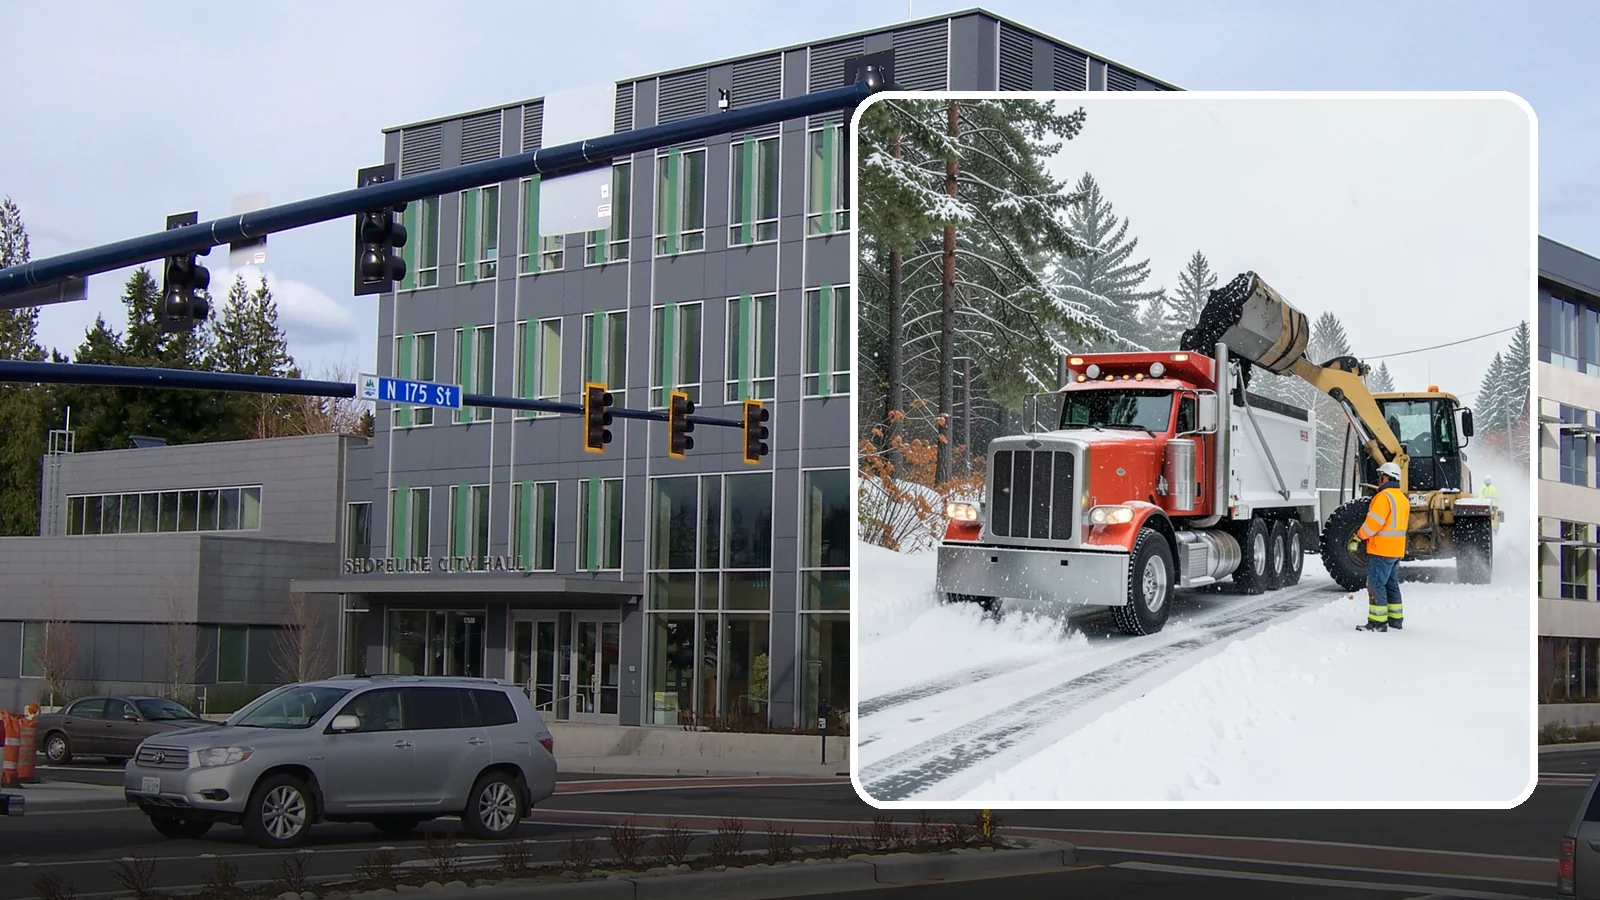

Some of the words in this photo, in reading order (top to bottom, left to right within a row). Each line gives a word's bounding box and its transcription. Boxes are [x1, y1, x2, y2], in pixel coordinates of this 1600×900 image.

[387, 380, 396, 399] N
[405, 382, 428, 403] 175
[436, 386, 452, 406] St
[344, 557, 431, 574] SHORELINE
[438, 556, 475, 573] CITY
[483, 555, 526, 571] HALL
